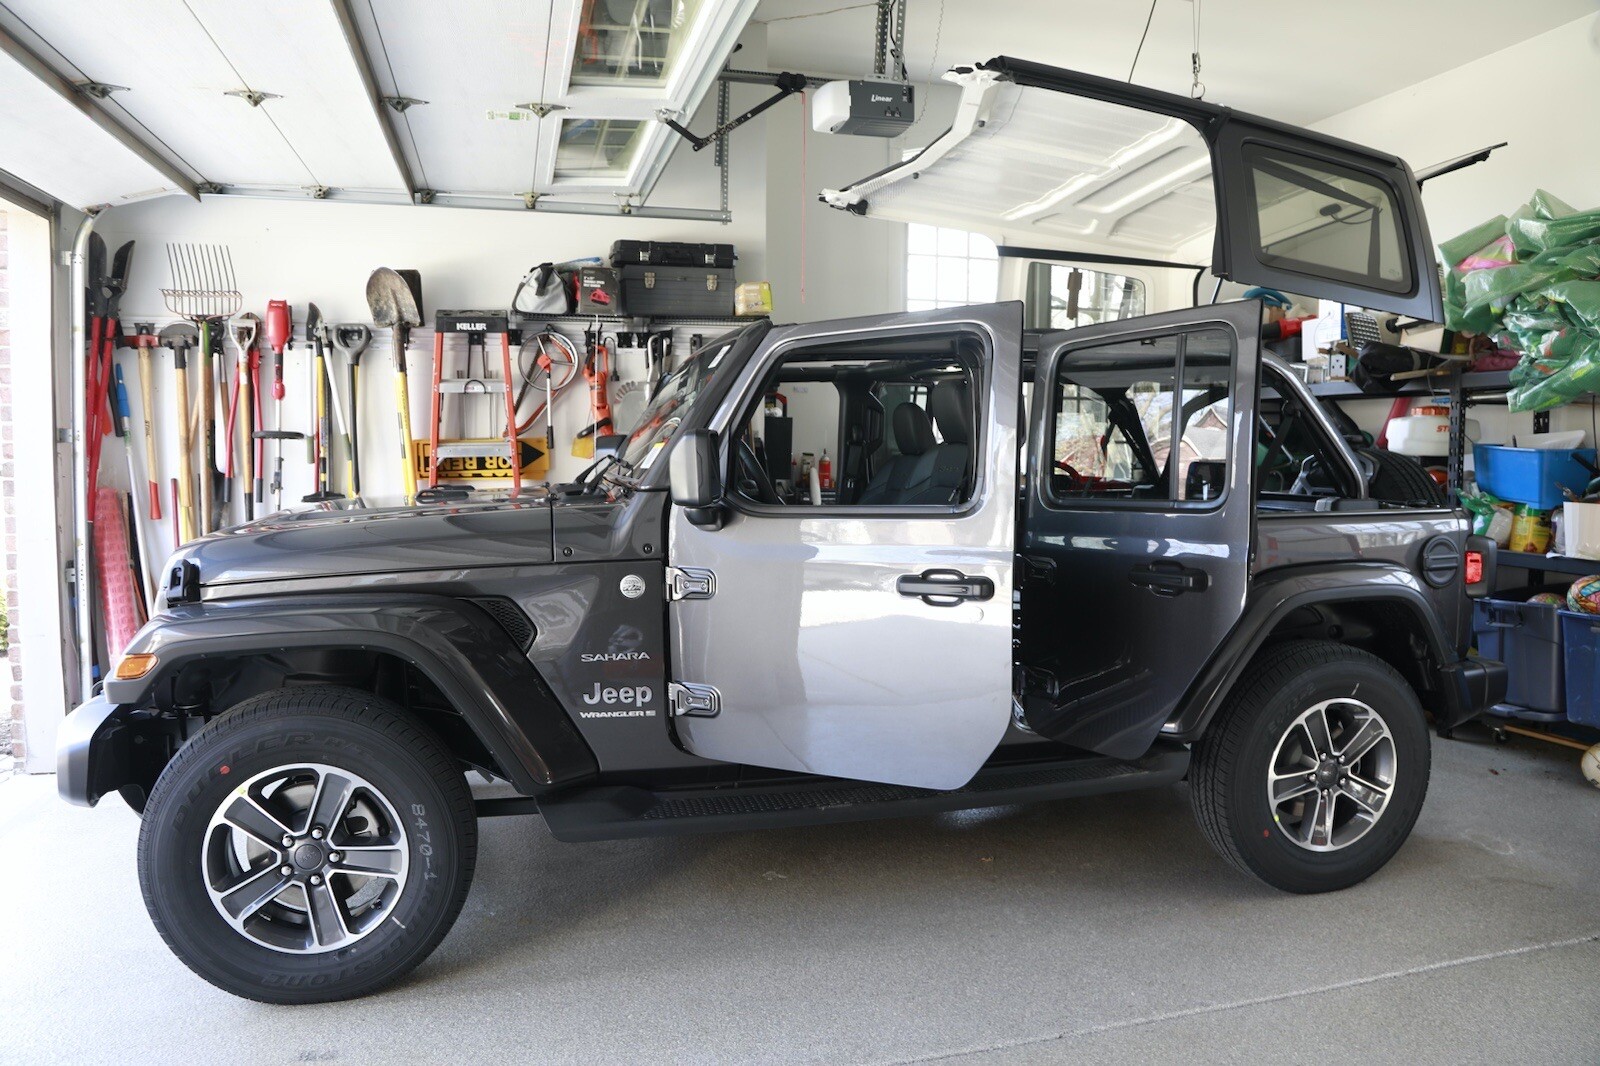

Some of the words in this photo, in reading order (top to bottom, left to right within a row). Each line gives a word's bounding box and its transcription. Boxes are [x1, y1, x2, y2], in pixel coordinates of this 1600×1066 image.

[871, 94, 893, 102] Linear
[456, 322, 487, 331] KELLER
[485, 456, 512, 470] OR
[581, 652, 650, 662] SAHARA
[583, 682, 653, 707] Jeep
[579, 710, 644, 718] WRANGLER
